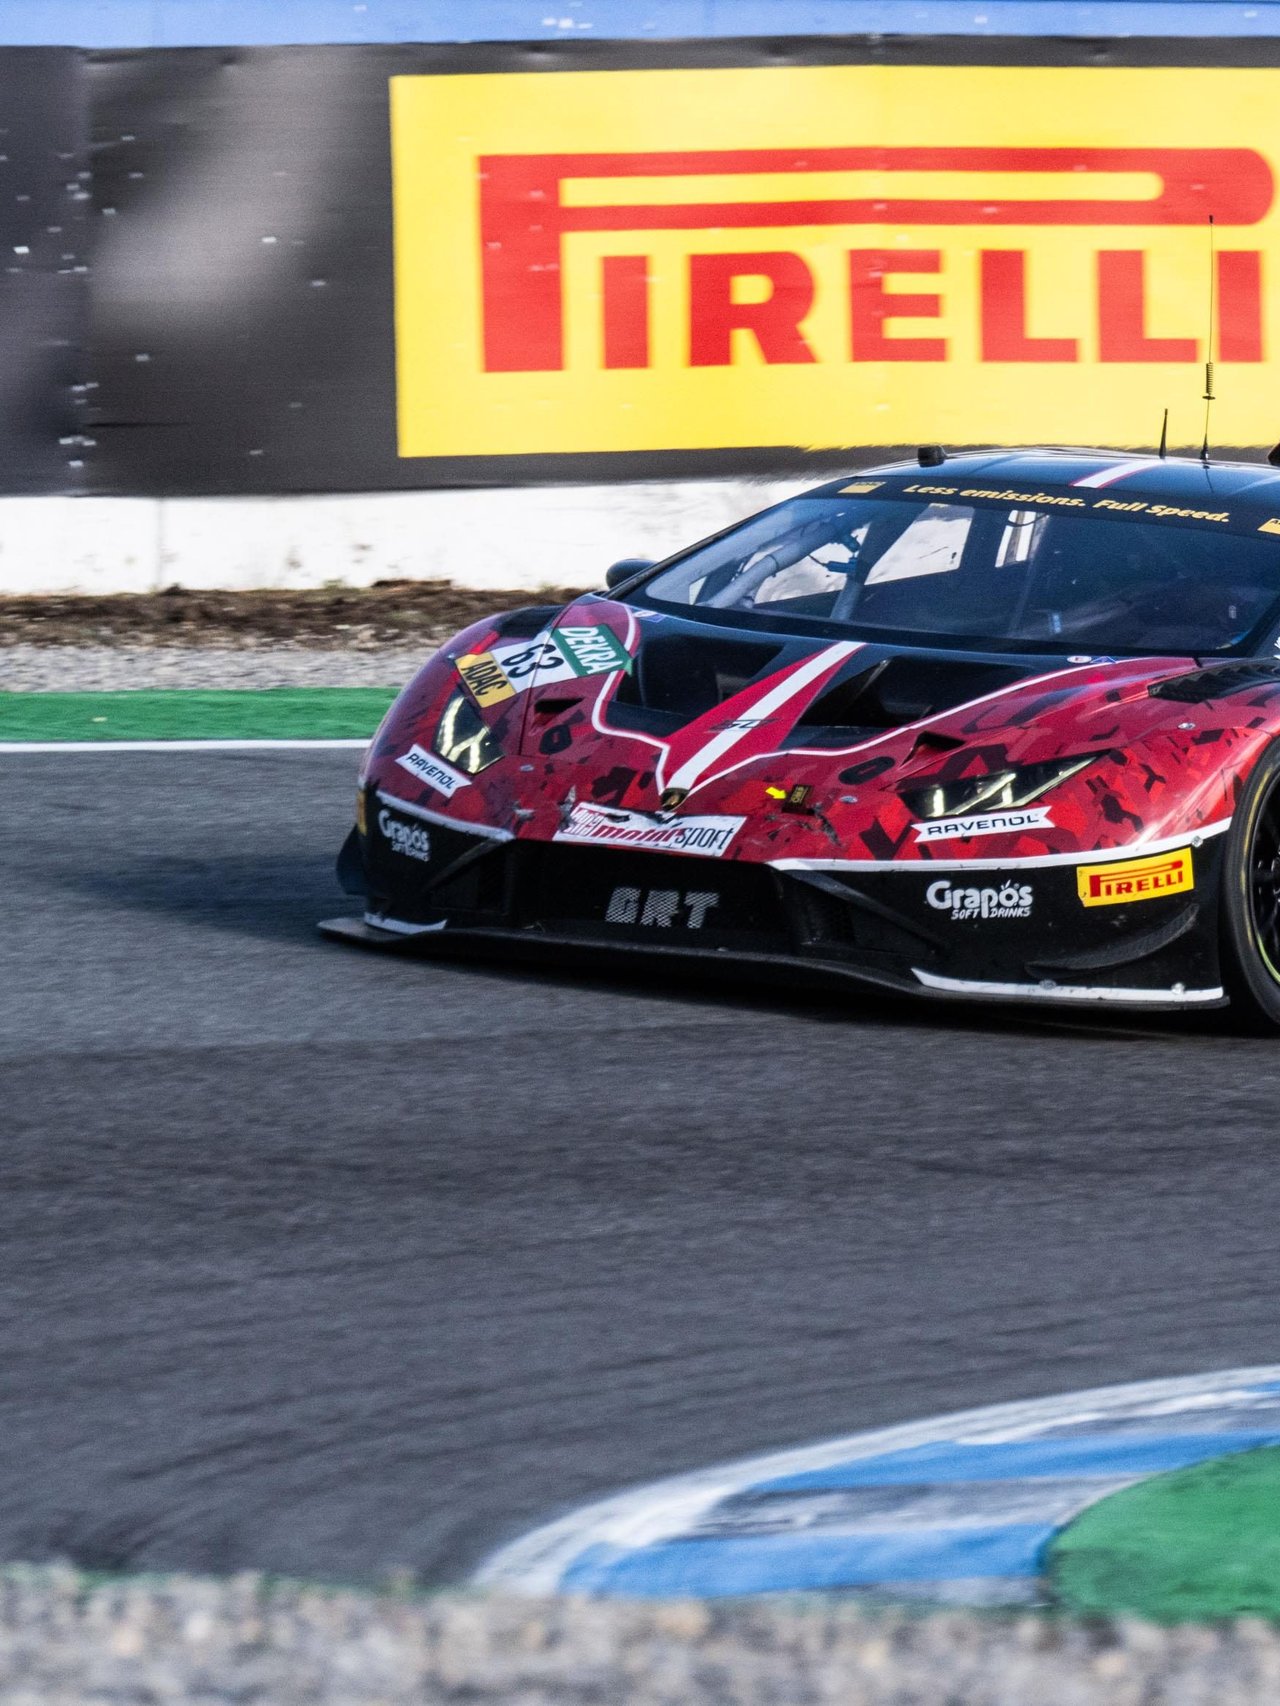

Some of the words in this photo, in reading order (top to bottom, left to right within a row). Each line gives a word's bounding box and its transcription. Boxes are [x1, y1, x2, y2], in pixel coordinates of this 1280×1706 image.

[477, 146, 1276, 373] PIRELLI
[903, 484, 959, 496] Less
[959, 489, 1086, 507] emissions.
[1093, 499, 1149, 512] Full
[1145, 505, 1230, 523] Speed.
[502, 643, 565, 679] 63
[558, 627, 623, 675] DEKRA
[461, 660, 508, 697] ADAC
[406, 753, 457, 790] RAVENOL
[927, 815, 1039, 836] RAVENOL
[1089, 860, 1183, 898] PIRELLI
[605, 886, 720, 930] GRT
[951, 908, 981, 920] SOFT
[989, 906, 1032, 918] DRINKS
